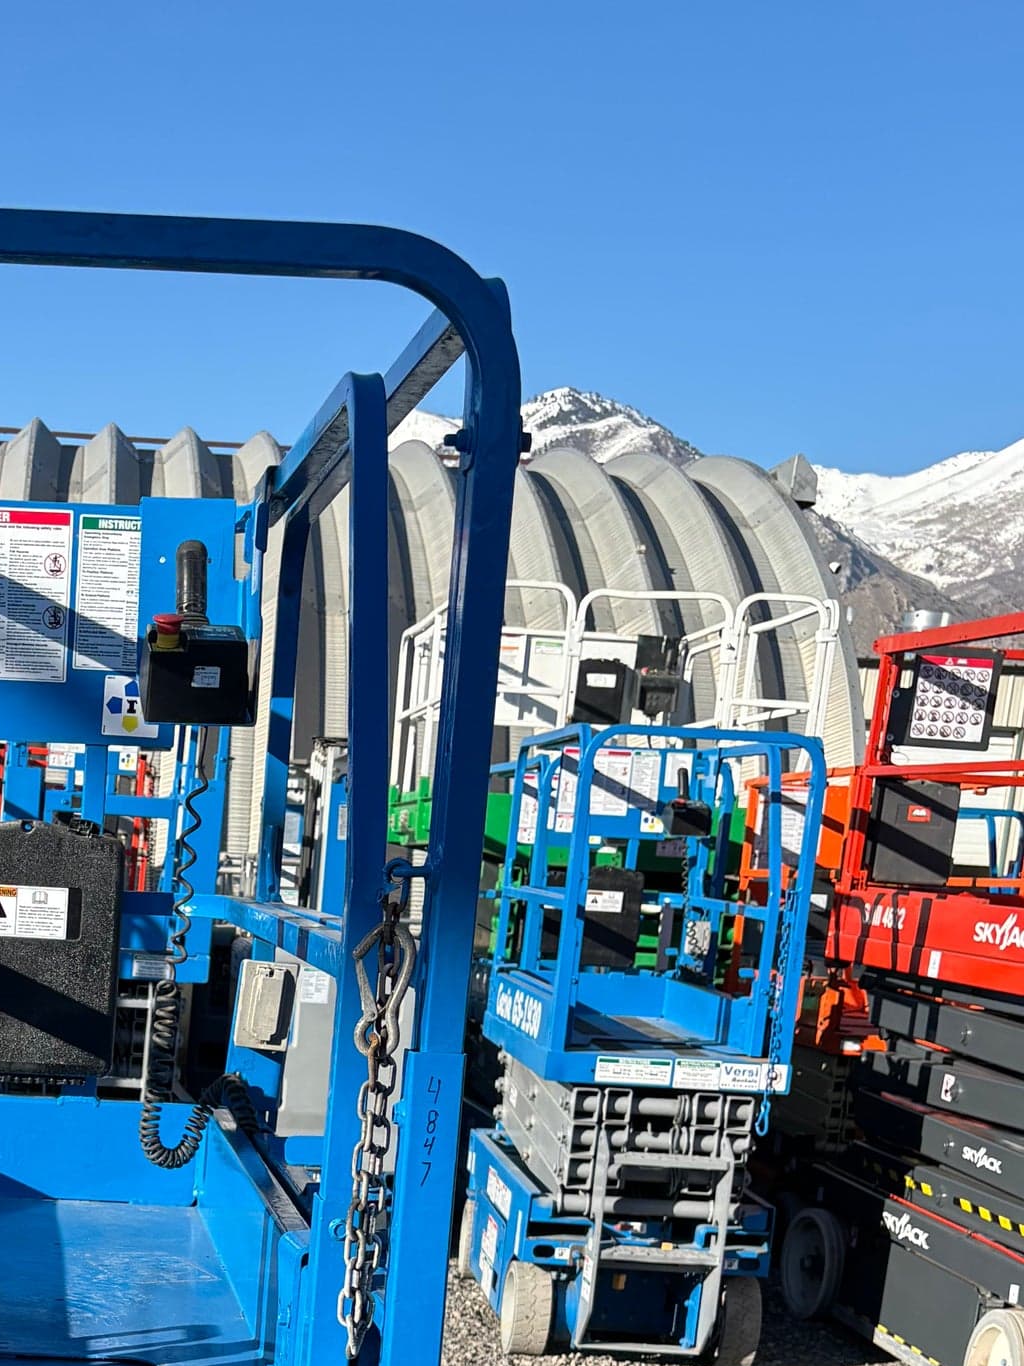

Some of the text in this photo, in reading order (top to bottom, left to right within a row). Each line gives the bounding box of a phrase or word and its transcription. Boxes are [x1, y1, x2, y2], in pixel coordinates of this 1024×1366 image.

[98, 519, 142, 530] INSTRUCT
[511, 989, 542, 1040] GS-1930
[724, 1065, 759, 1078] Versi
[962, 1146, 1002, 1174] SKYJACK
[881, 1211, 930, 1250] SKYJACK
